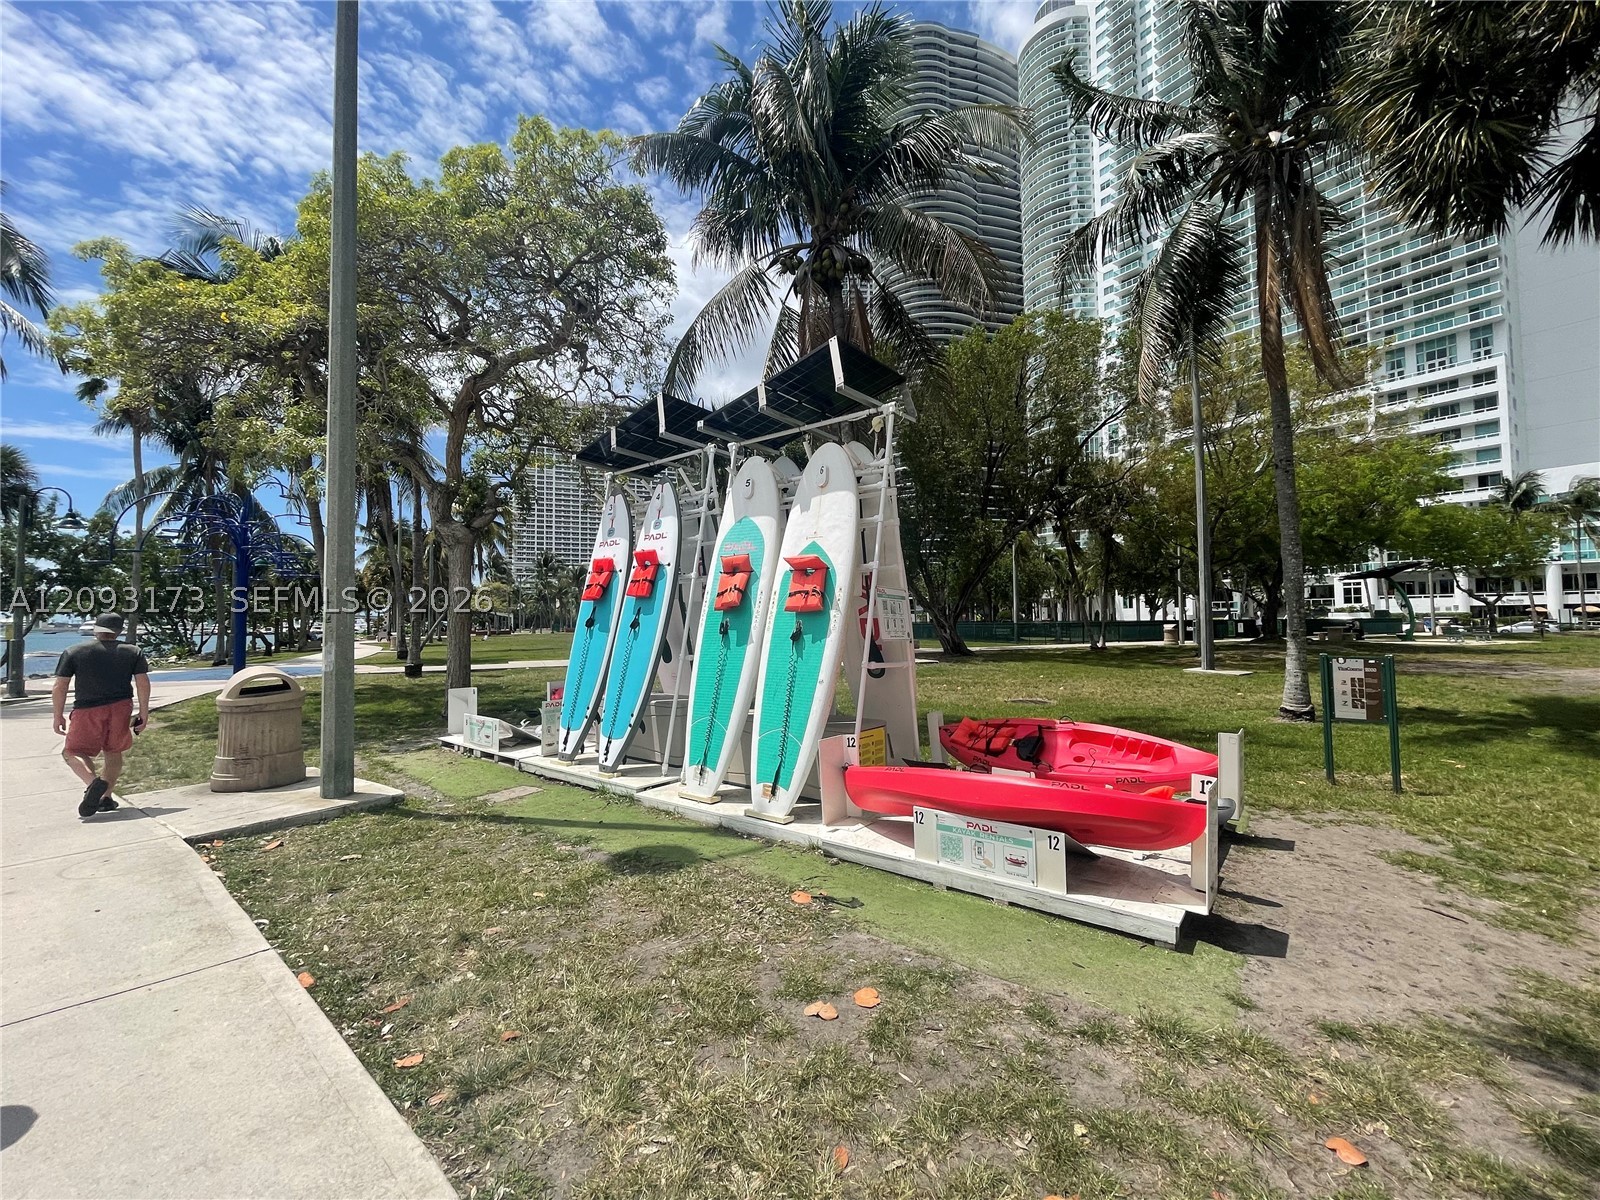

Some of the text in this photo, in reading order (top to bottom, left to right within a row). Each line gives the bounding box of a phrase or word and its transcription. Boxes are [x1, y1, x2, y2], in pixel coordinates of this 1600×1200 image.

[745, 478, 751, 487] 5
[644, 533, 667, 541] PADL
[599, 540, 620, 548] PADL
[847, 737, 856, 747] 12
[1115, 776, 1146, 784] PADL
[1050, 781, 1090, 791] PADL
[914, 810, 924, 825] 12
[966, 821, 997, 834] PADL
[952, 827, 1014, 844] KAYAK RENTALS
[1047, 834, 1060, 851] 12
